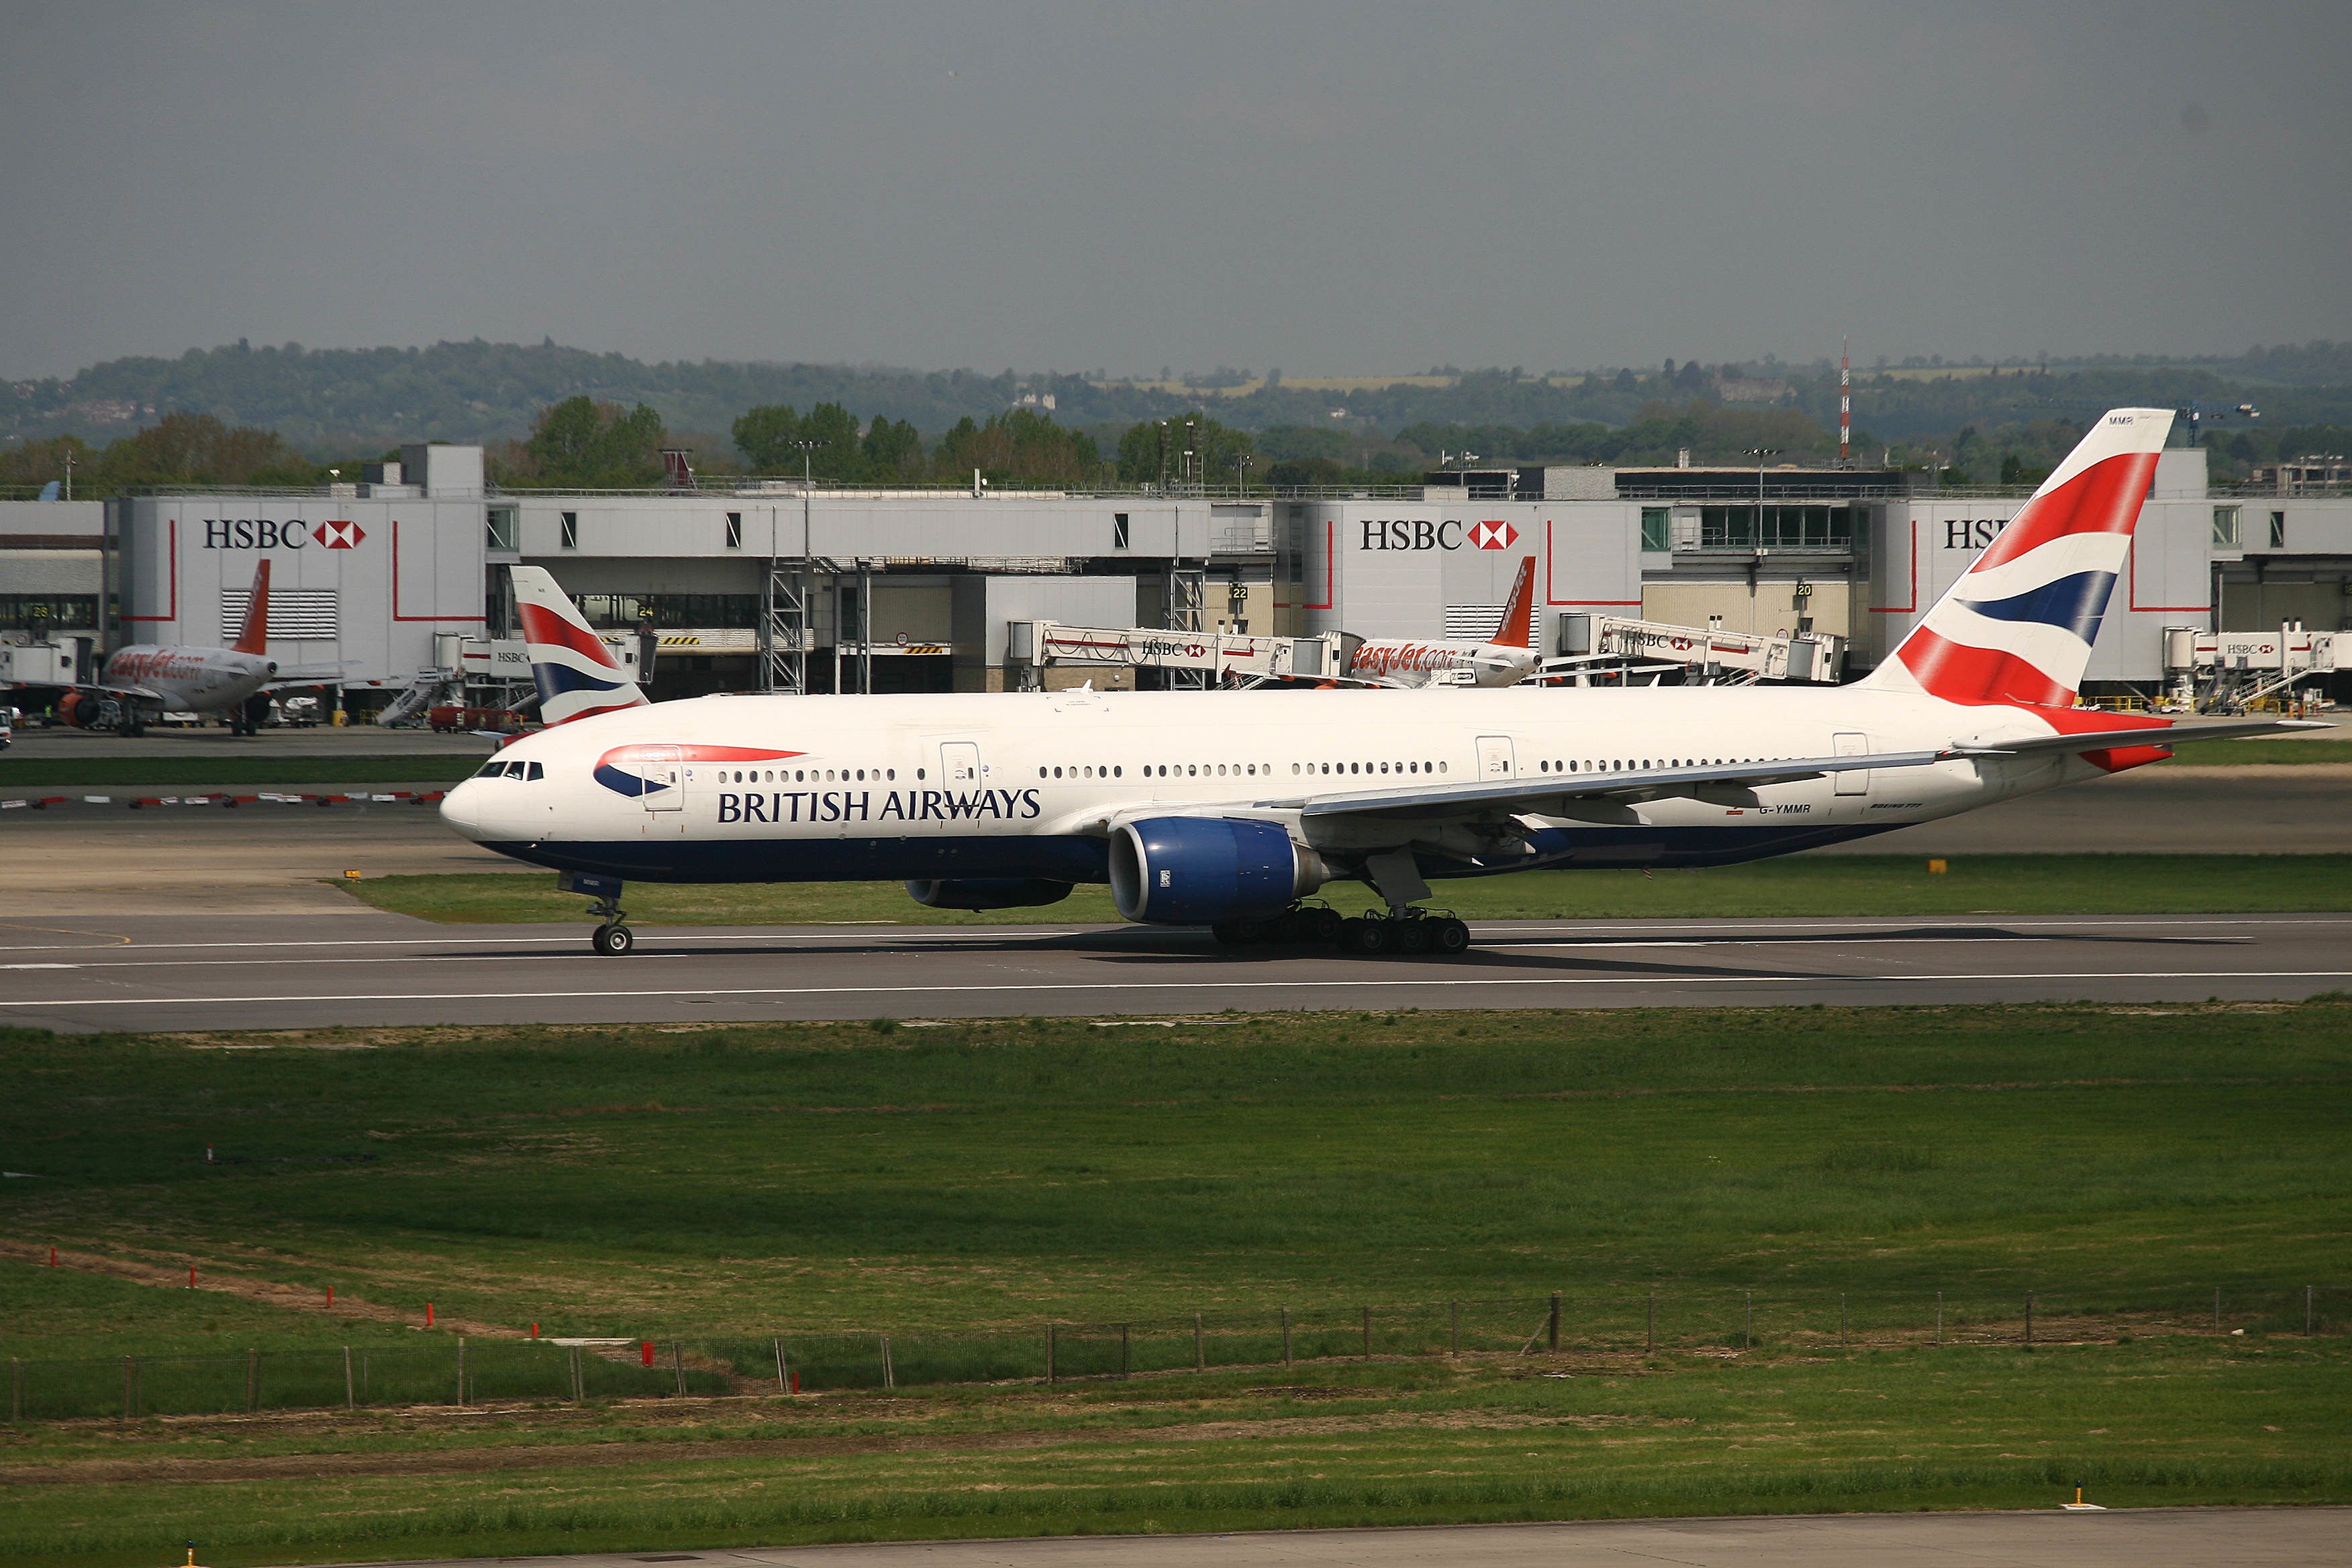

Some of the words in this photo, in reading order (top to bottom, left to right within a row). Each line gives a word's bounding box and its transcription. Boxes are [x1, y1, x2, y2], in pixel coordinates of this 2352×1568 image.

[2109, 416, 2133, 426] MMR
[203, 520, 307, 549] HSBC
[1360, 520, 1463, 550] HSBC
[1943, 519, 2011, 550] HS
[1233, 588, 1247, 598] 22
[1798, 585, 1811, 595] 20
[639, 606, 654, 617] 24
[1141, 640, 1183, 656] HSBC
[2227, 644, 2258, 654] HSBC
[497, 652, 526, 663] HSBC
[718, 791, 869, 823] BRITISH
[878, 789, 1041, 821] AIRWAYS
[1759, 804, 1811, 814] G-YMMR
